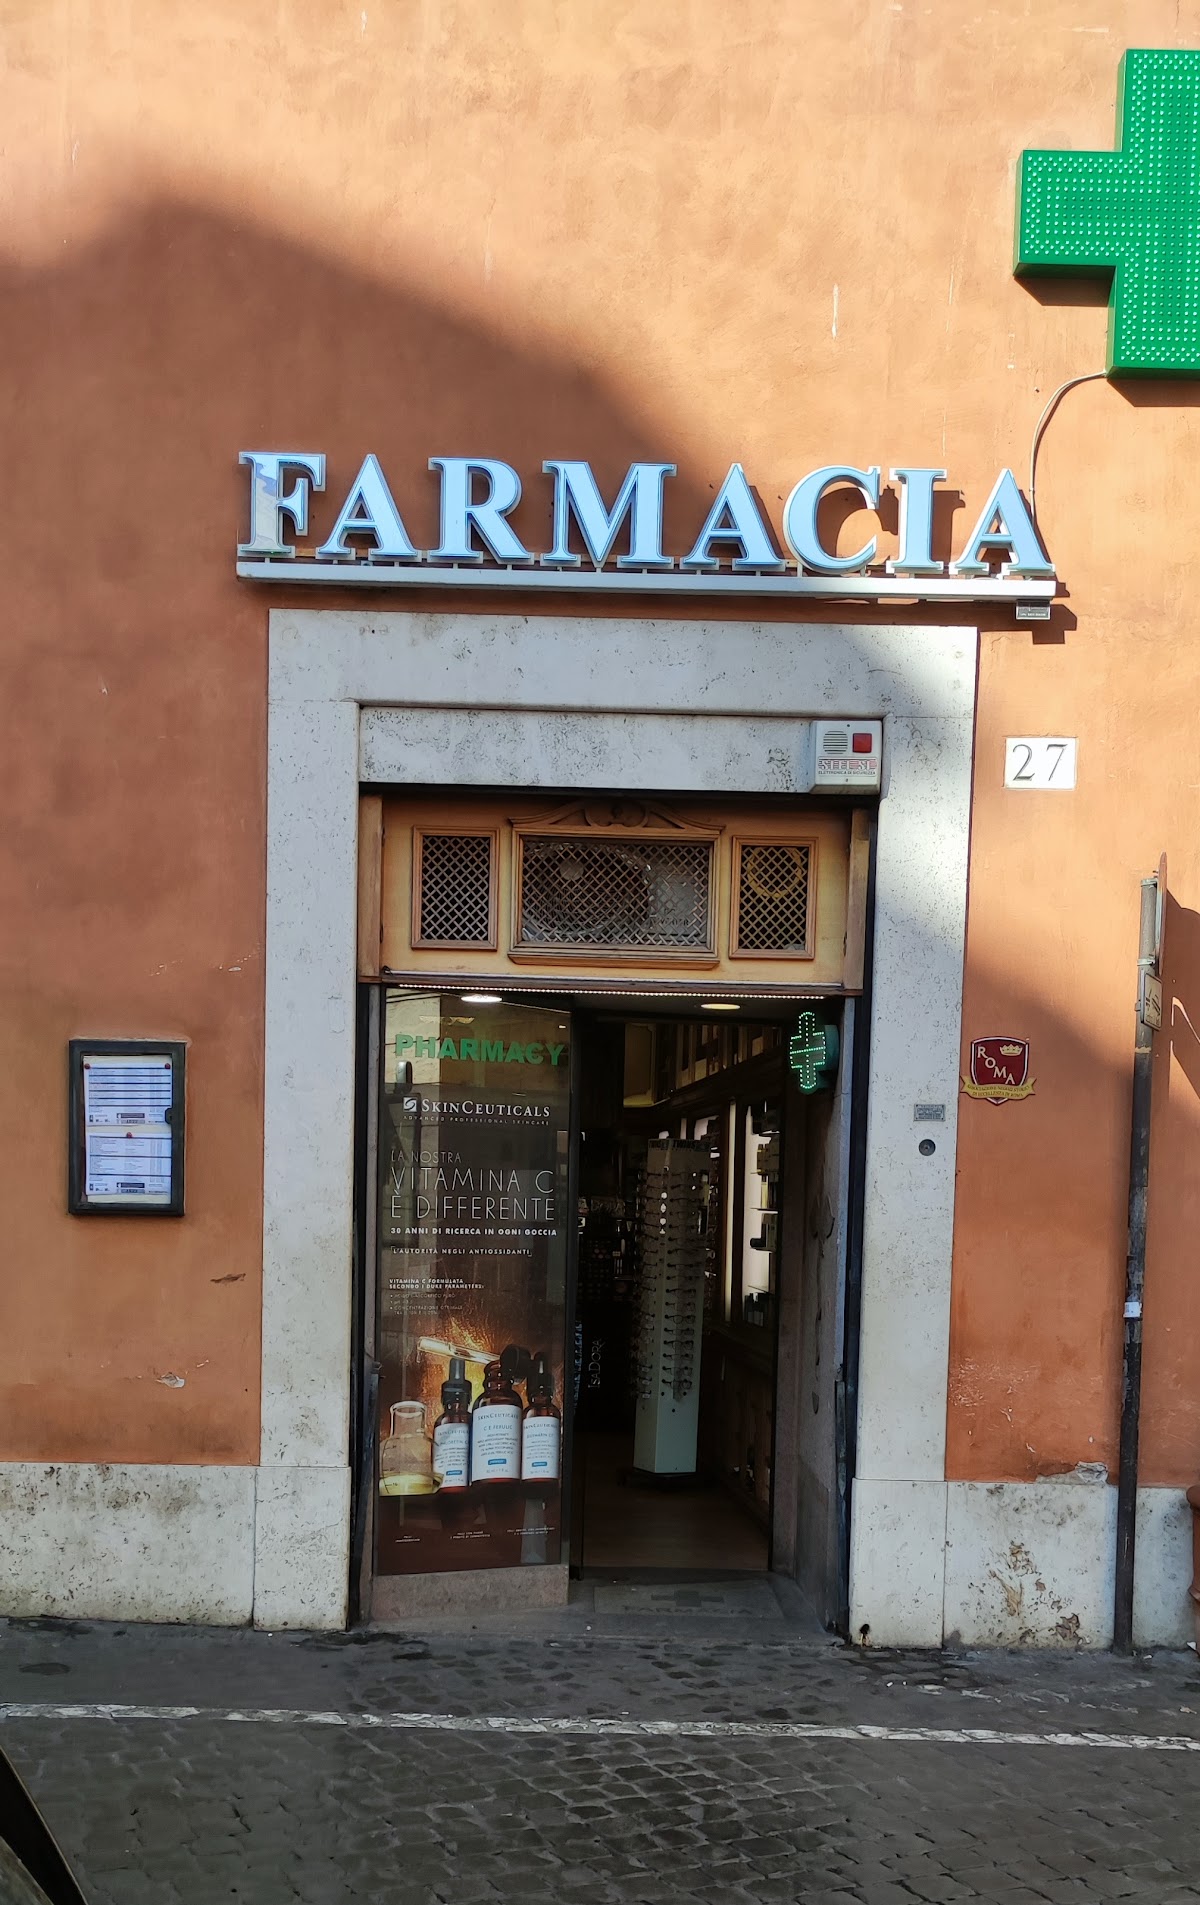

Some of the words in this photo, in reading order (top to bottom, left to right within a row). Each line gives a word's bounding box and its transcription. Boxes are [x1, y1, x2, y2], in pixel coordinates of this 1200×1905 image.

[238, 451, 1055, 574] FARMACIA
[1012, 743, 1068, 782] 27
[395, 1034, 565, 1066] PHARMACY
[977, 1046, 1016, 1085] ROMA
[391, 1150, 405, 1162] LA
[411, 1150, 462, 1164] NOSTRA
[391, 1167, 521, 1192] VITAMINA
[535, 1170, 554, 1194] C
[391, 1189, 402, 1218] È
[417, 1195, 555, 1220] DIFFERENTE
